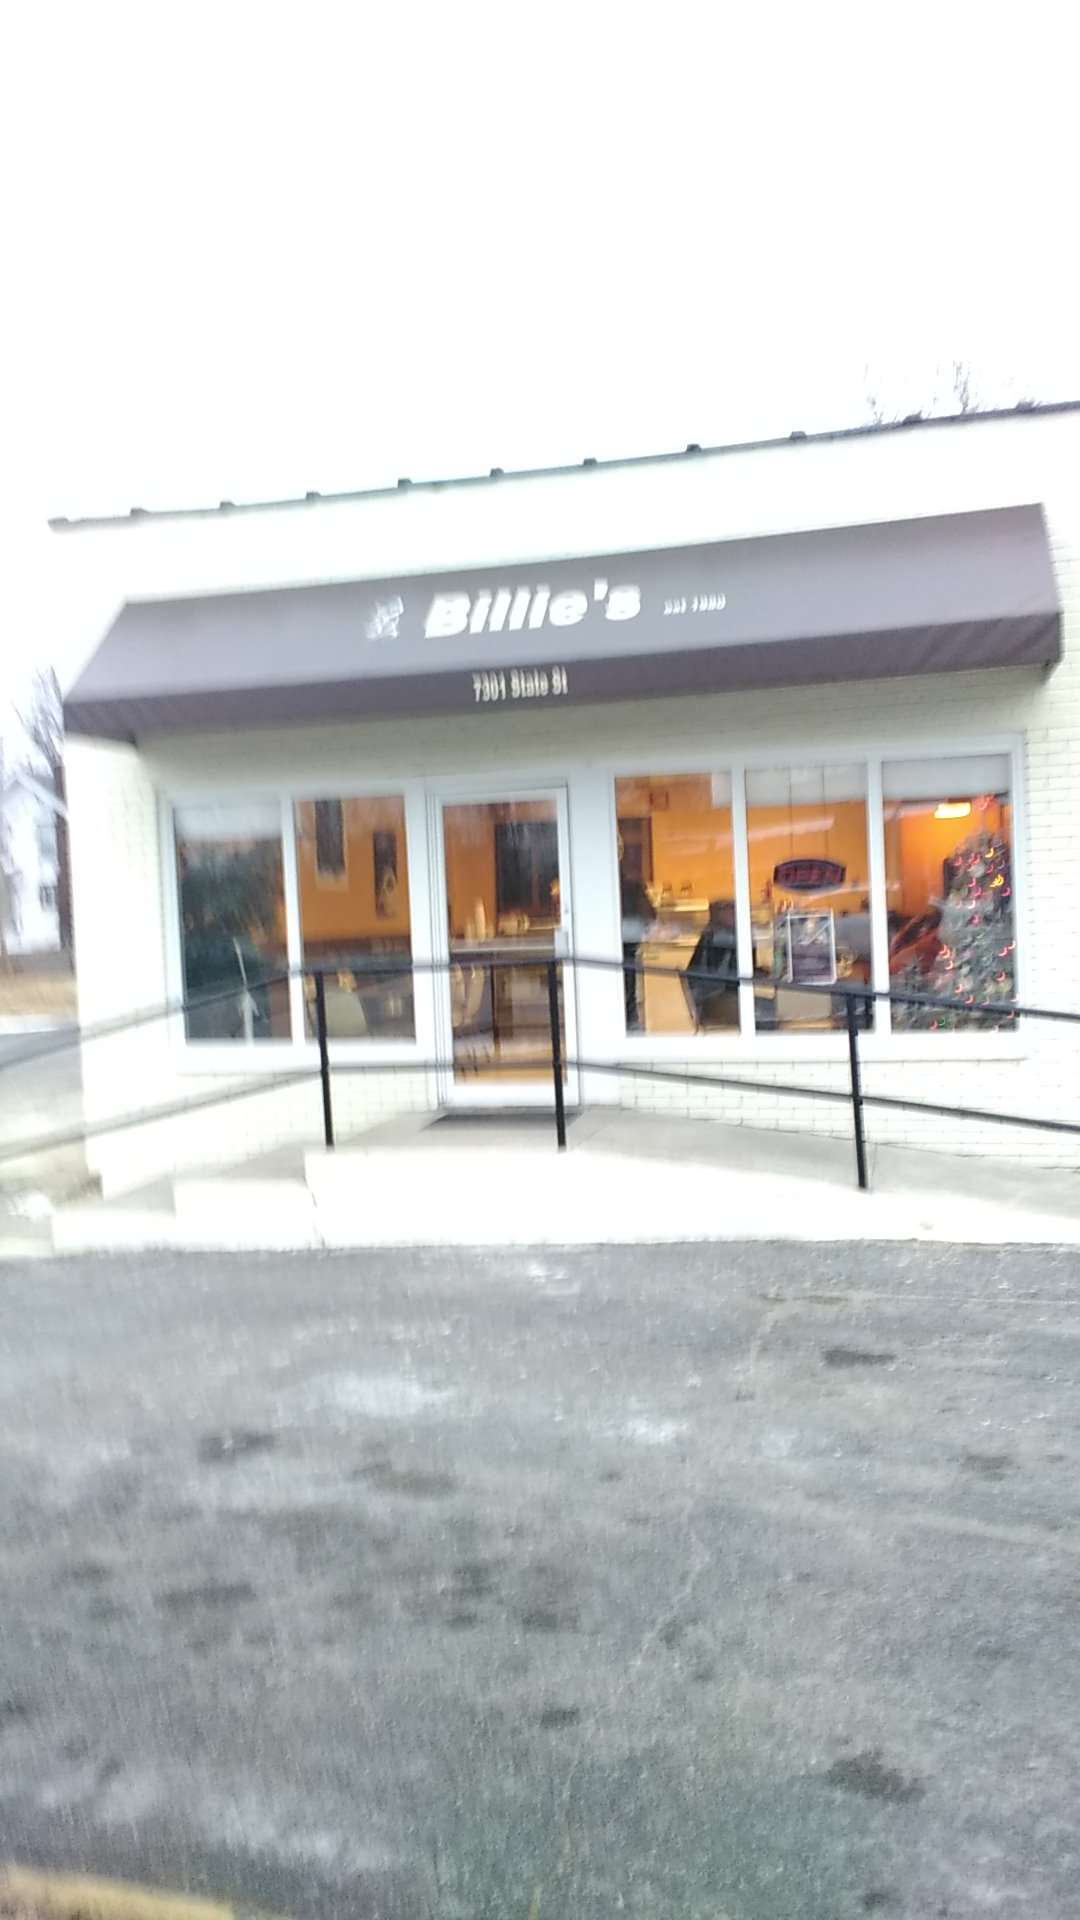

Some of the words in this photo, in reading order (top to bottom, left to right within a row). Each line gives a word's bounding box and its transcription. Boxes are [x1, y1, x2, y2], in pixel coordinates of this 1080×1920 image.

[424, 577, 641, 639] Billie's
[510, 668, 549, 698] State
[552, 665, 568, 695] St
[779, 865, 841, 884] OPEN
